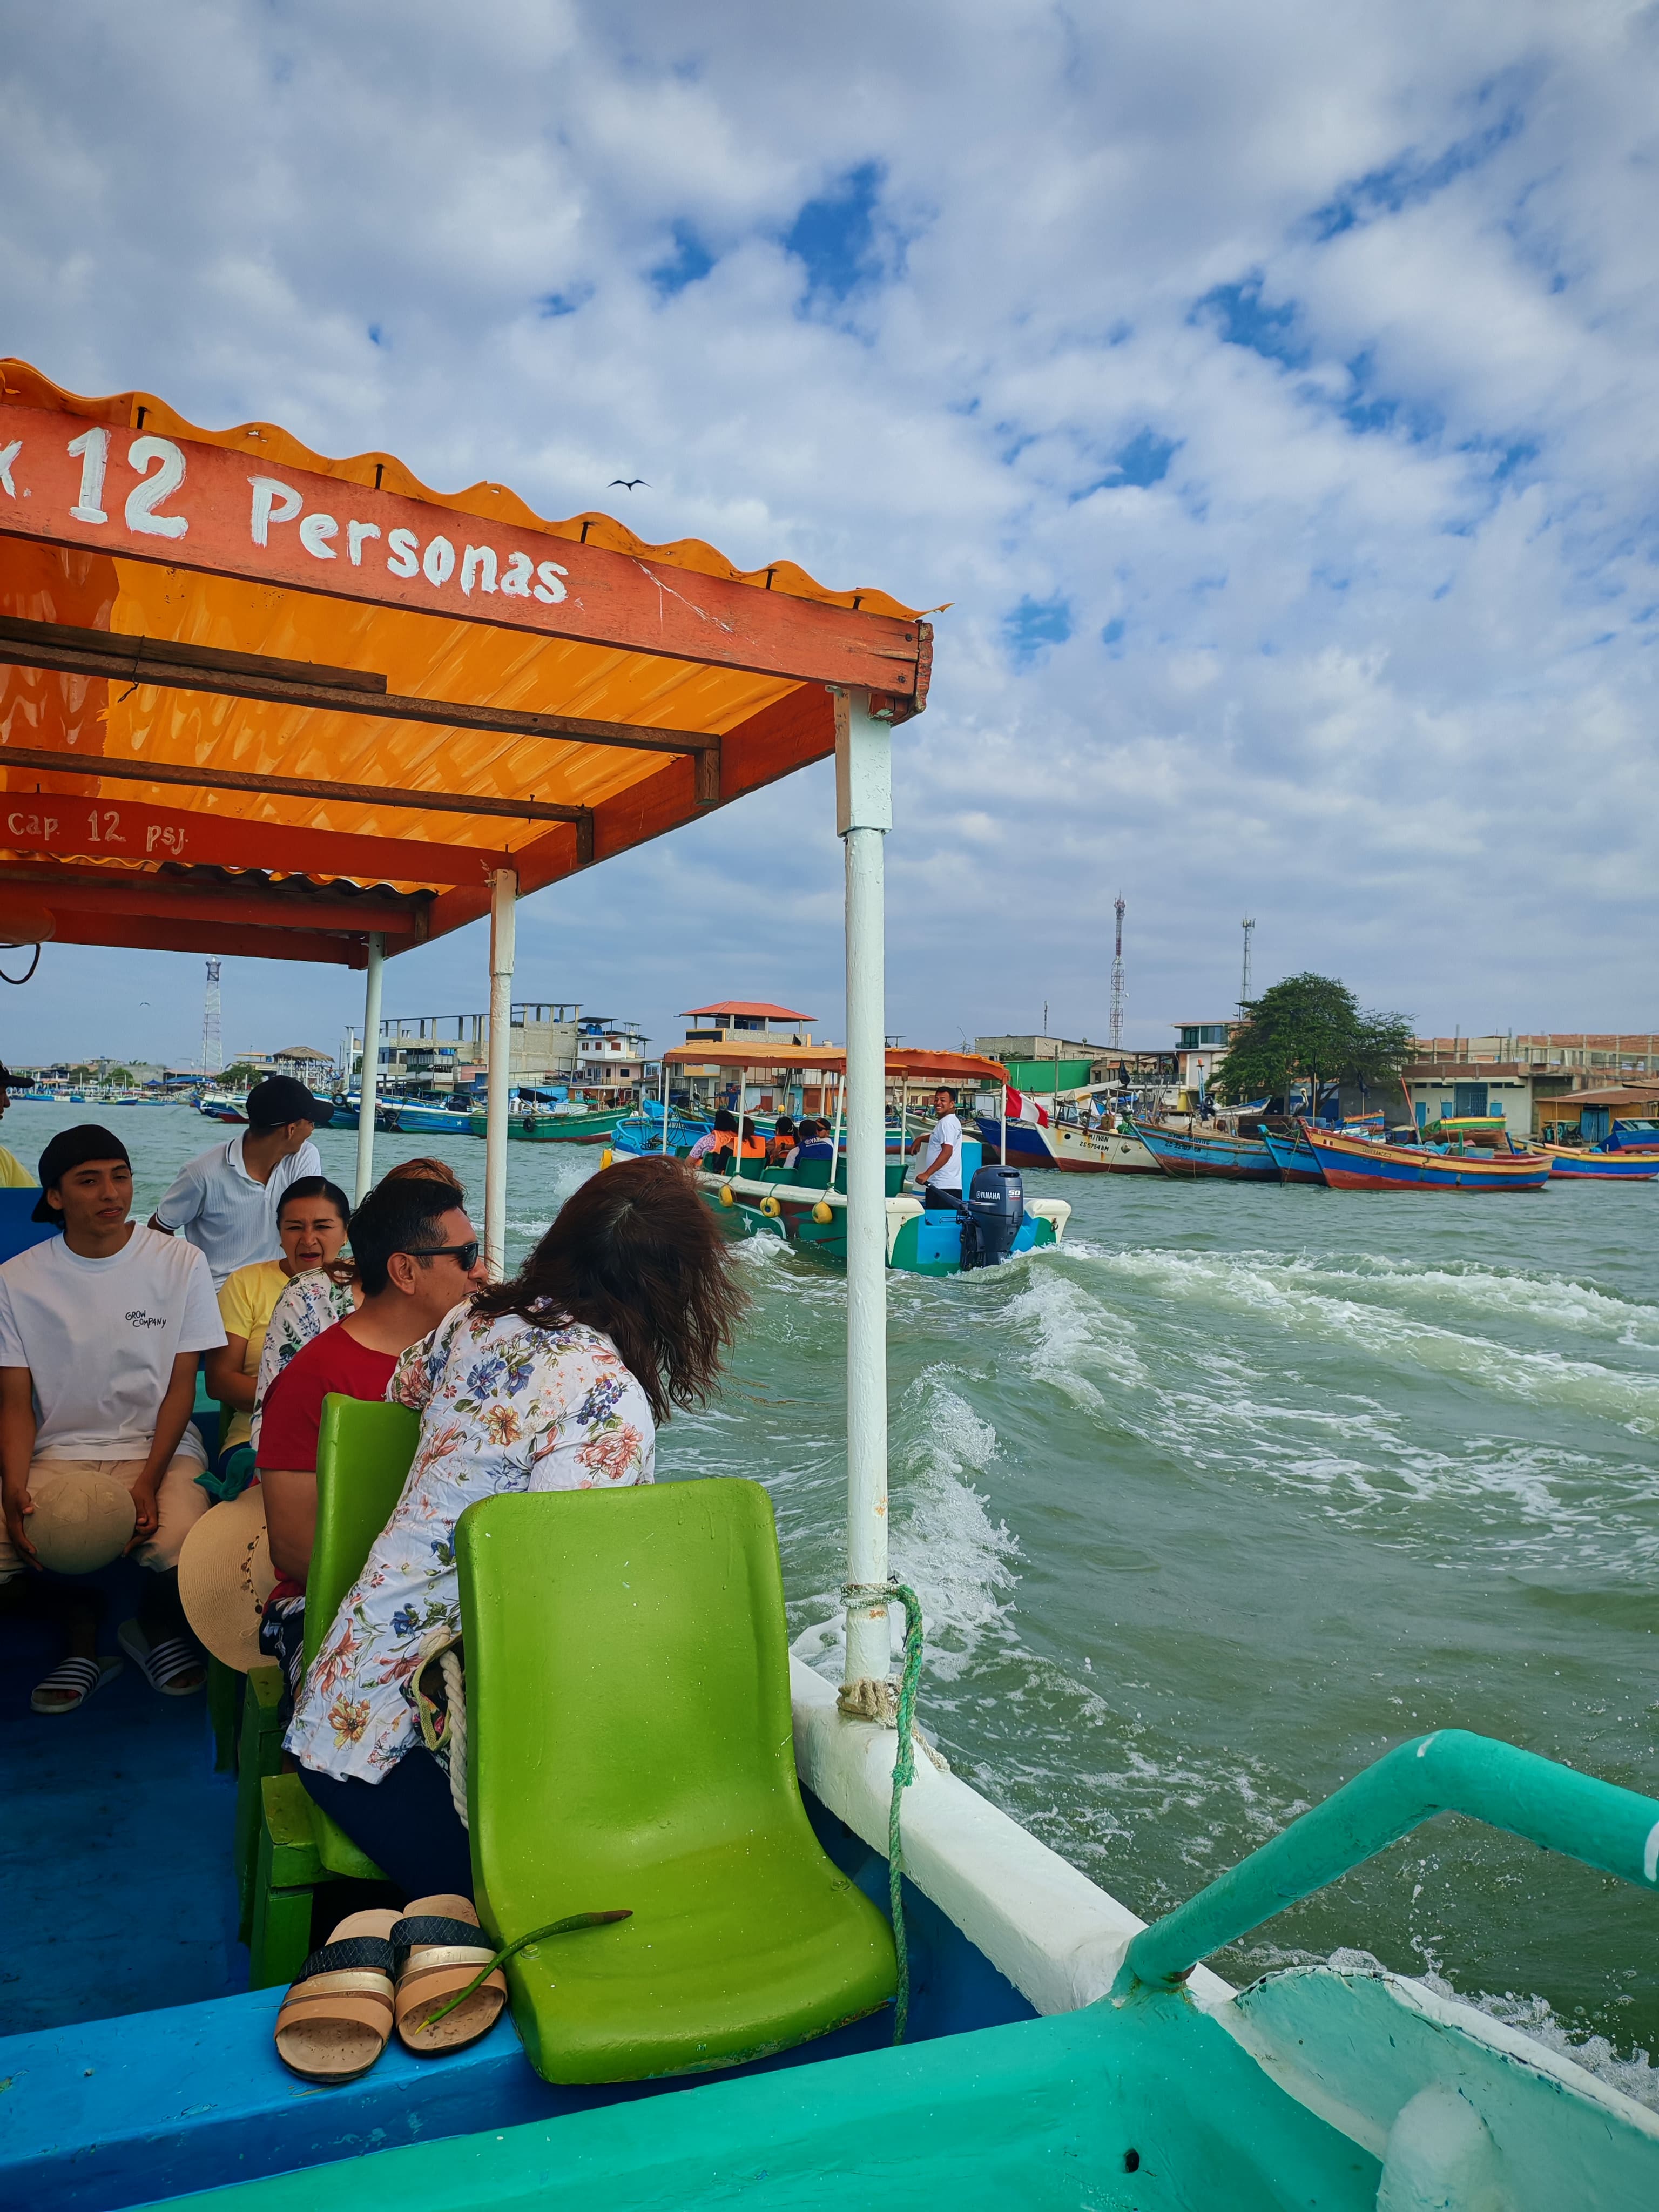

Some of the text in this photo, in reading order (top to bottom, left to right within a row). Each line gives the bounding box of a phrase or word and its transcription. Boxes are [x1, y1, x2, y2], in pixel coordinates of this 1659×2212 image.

[66, 427, 189, 540] 12
[247, 476, 570, 604] Personas
[87, 810, 126, 842] 12
[981, 1191, 1000, 1200] YAMAHA
[125, 1309, 146, 1321] GROW
[132, 1317, 167, 1329] COMPANY
